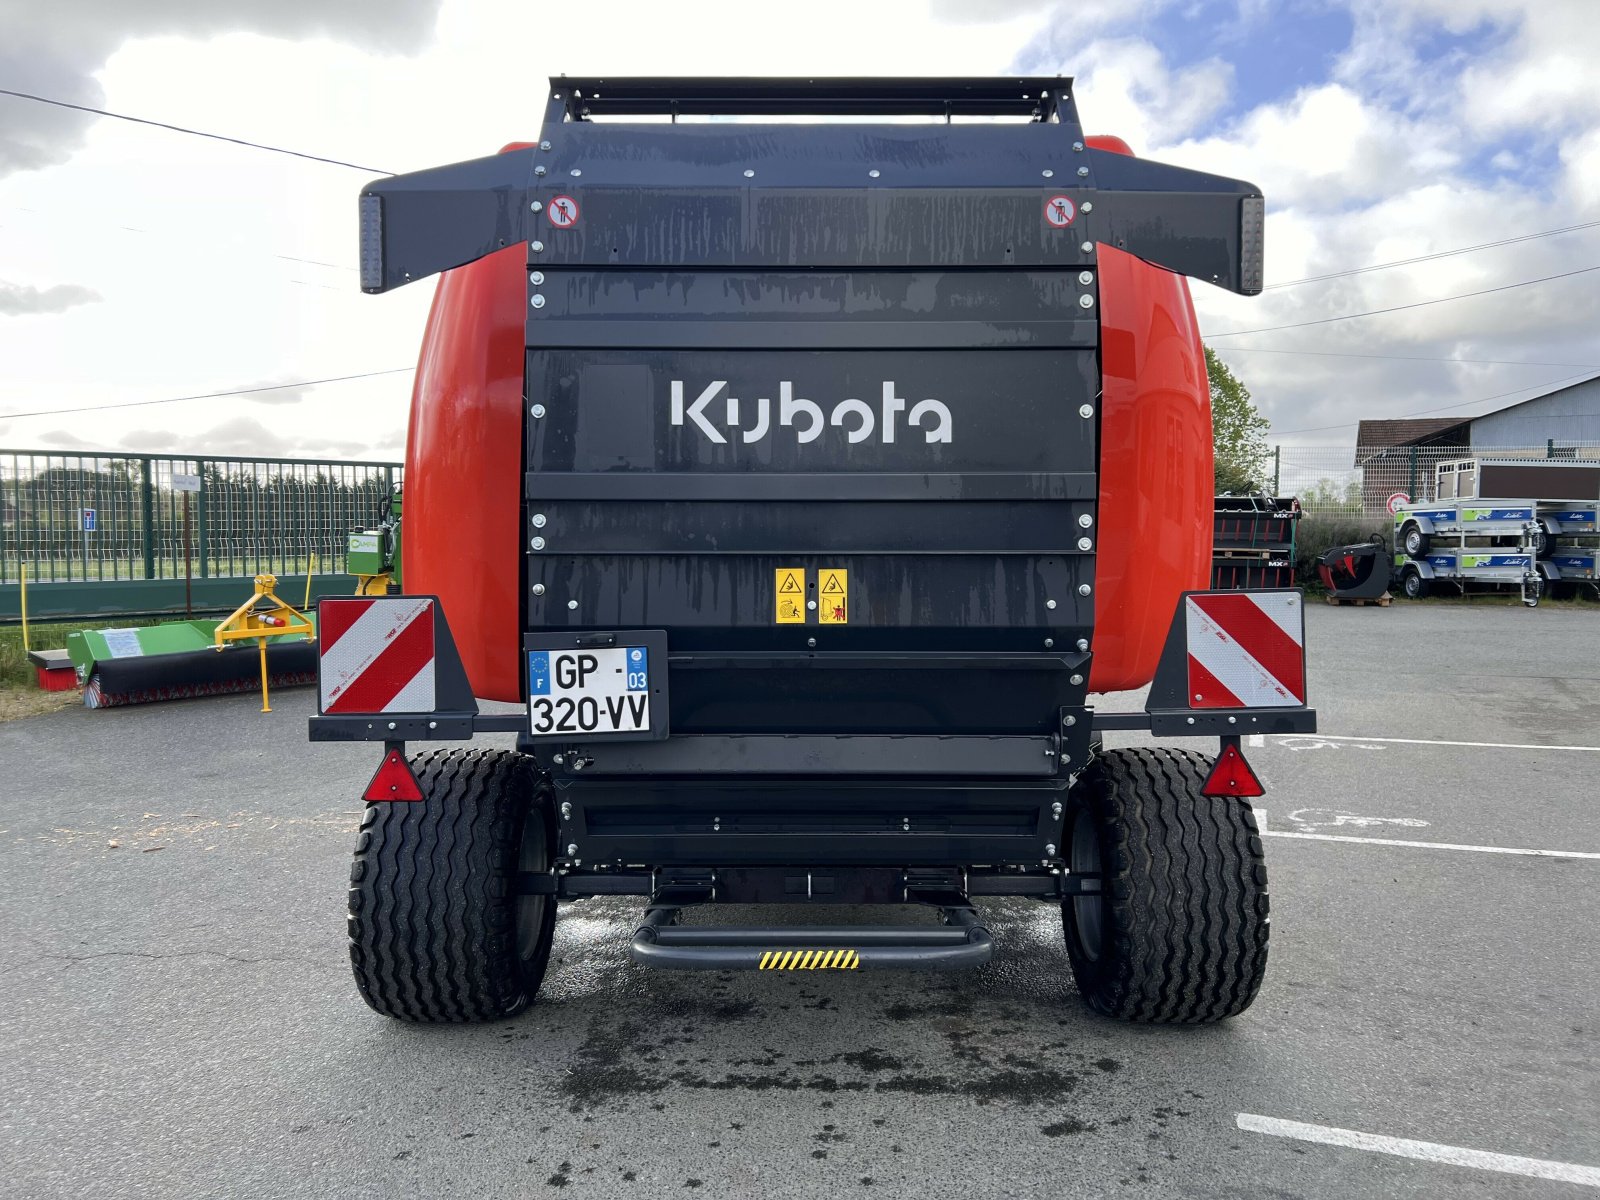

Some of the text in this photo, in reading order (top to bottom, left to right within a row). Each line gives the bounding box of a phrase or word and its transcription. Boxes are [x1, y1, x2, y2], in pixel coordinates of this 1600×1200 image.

[671, 380, 952, 444] Kubota
[536, 678, 544, 689] F
[628, 672, 647, 688] 03
[533, 695, 647, 733] 320-VV
